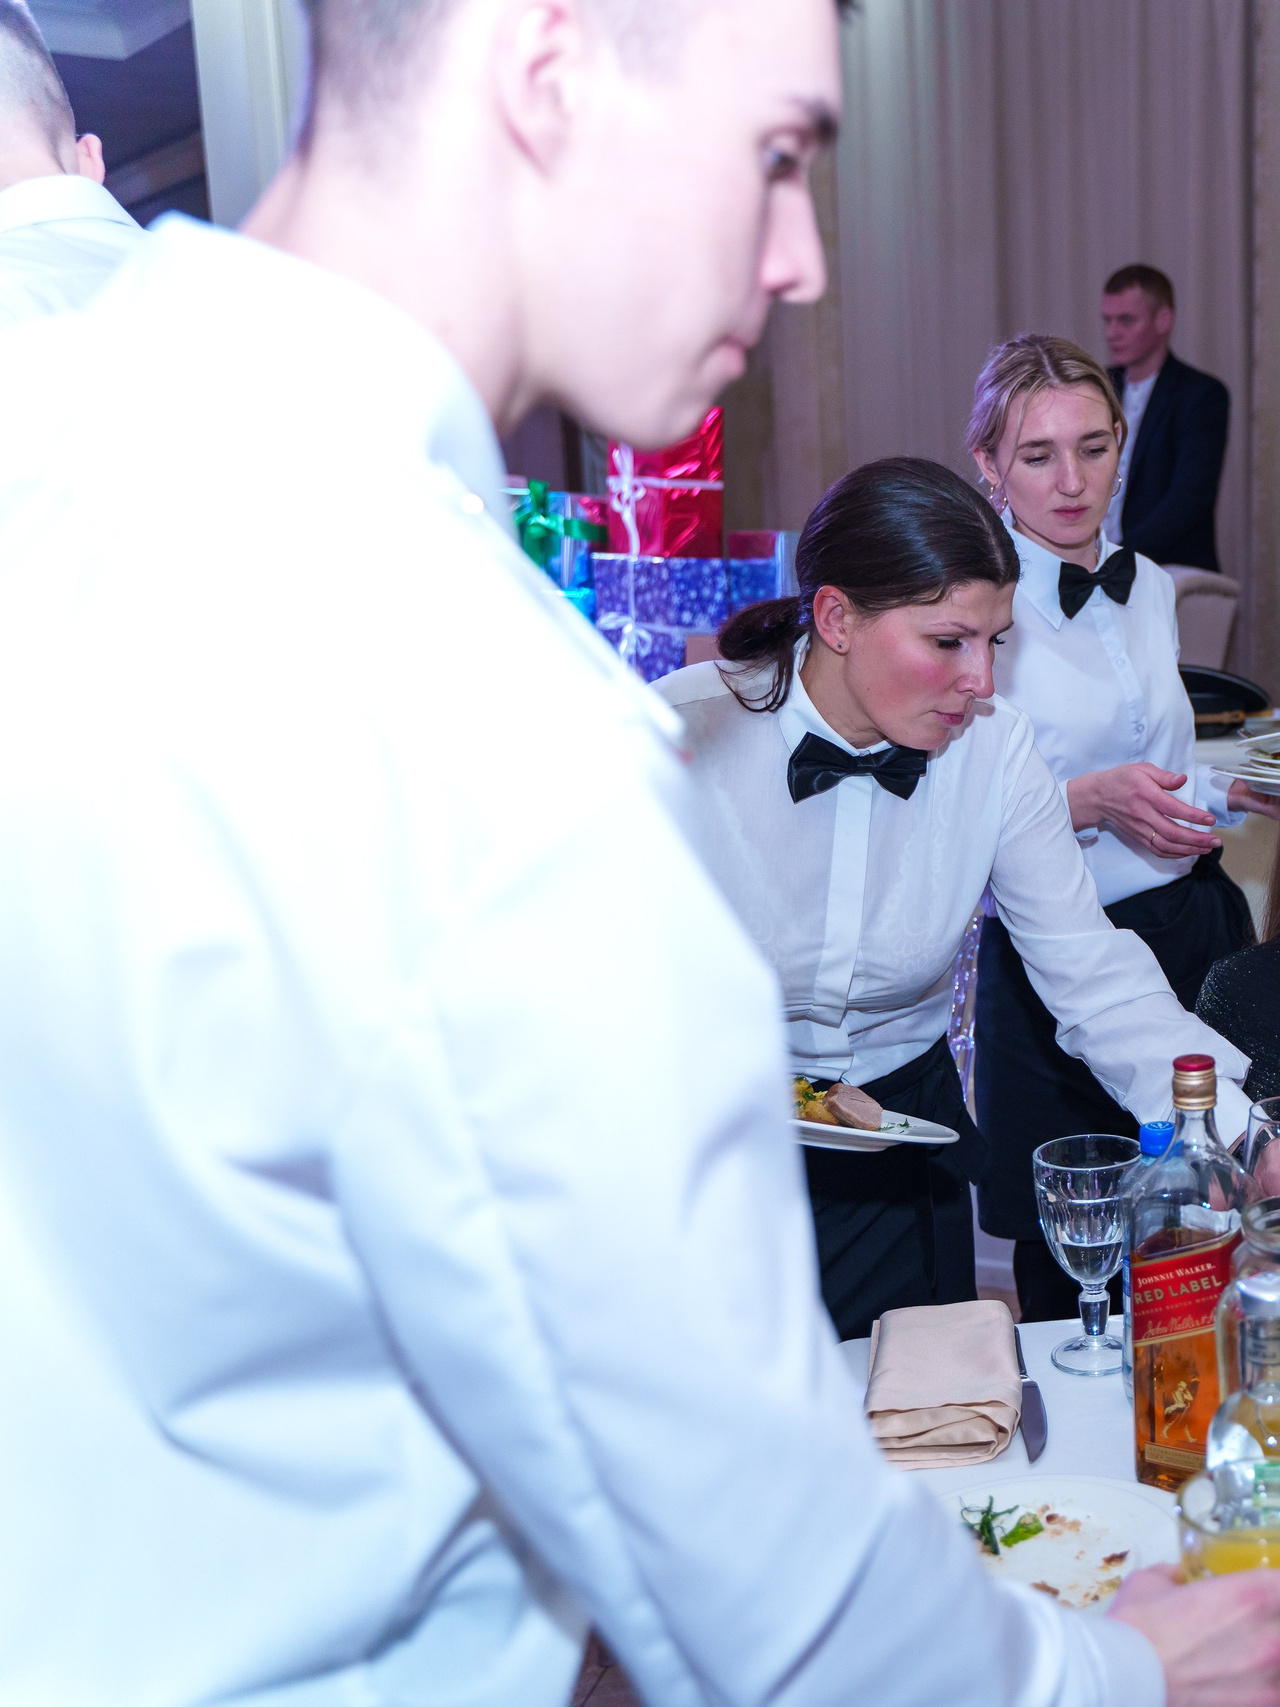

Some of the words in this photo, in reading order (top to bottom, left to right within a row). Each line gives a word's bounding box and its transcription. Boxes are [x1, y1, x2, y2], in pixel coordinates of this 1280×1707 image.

[1134, 1289, 1165, 1305] RED
[1168, 1275, 1222, 1297] LABEL
[1137, 1271, 1175, 1288] JOHNNIE
